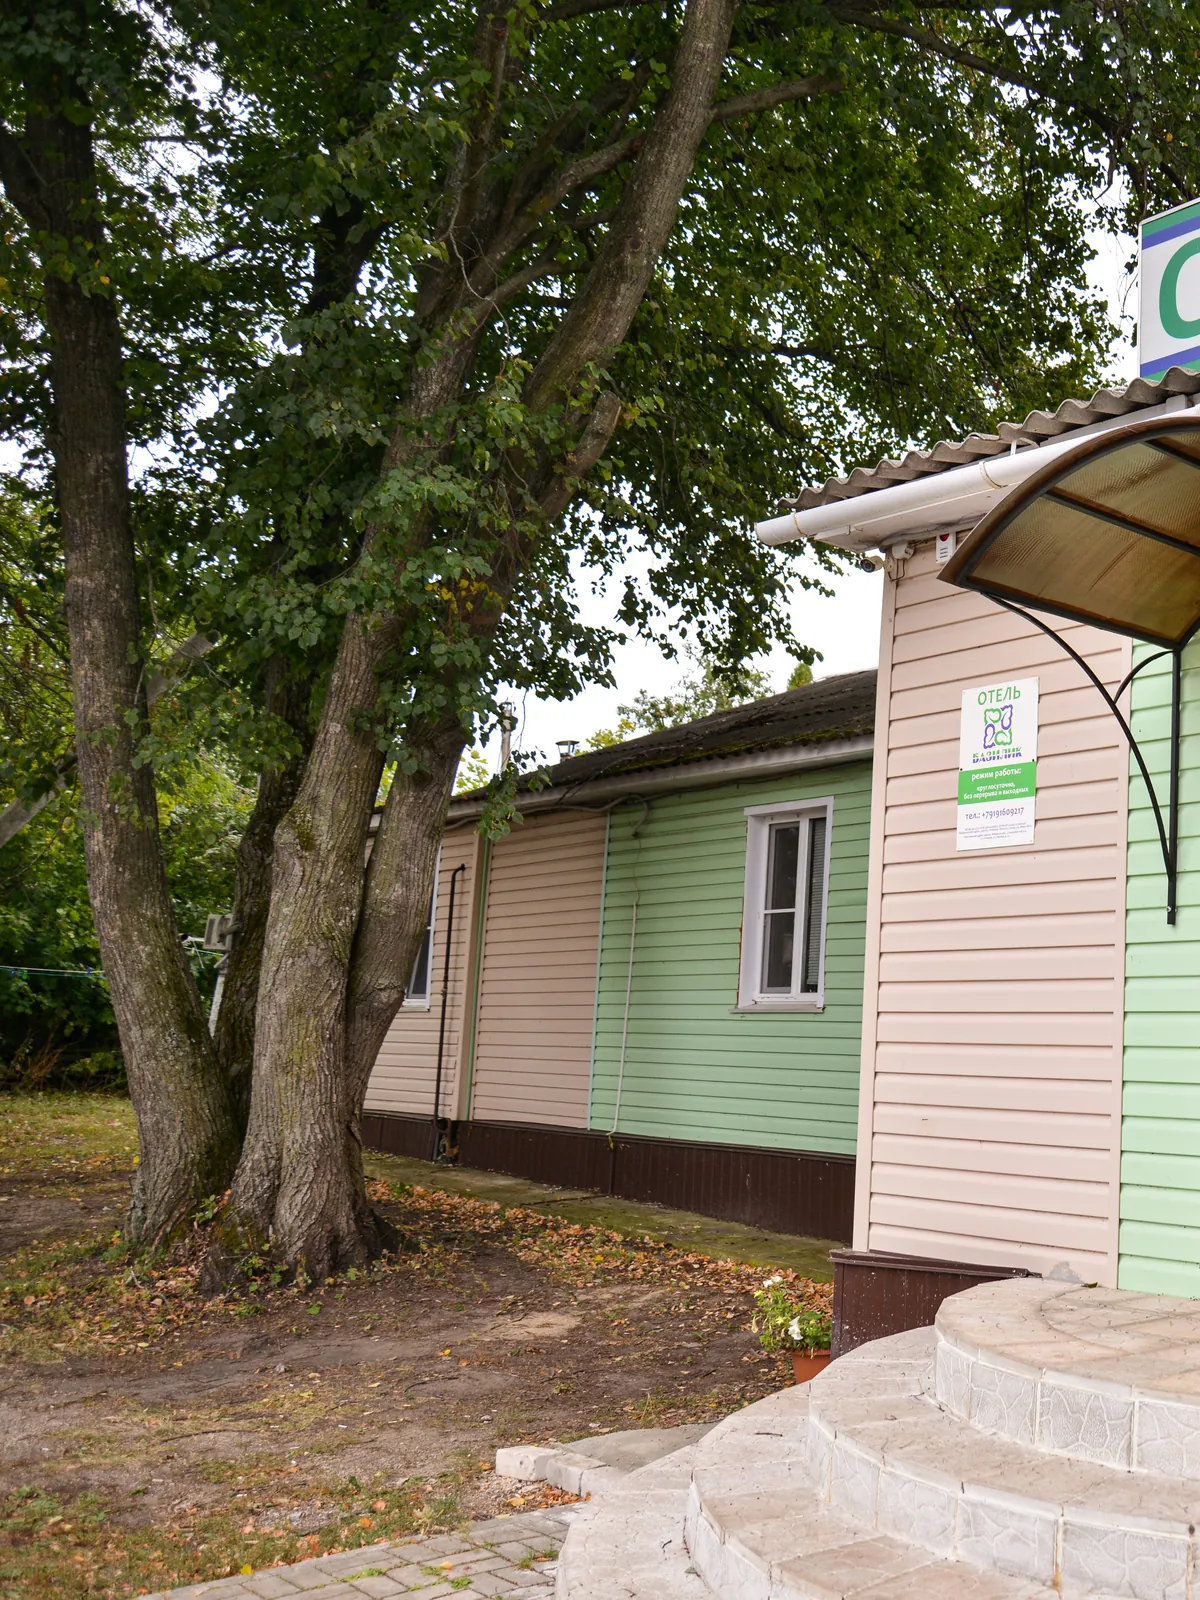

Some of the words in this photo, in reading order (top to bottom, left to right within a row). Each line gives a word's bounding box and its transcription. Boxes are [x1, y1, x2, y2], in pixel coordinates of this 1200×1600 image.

[977, 685, 1021, 706] ОТЕЛЬ
[971, 771, 994, 782] режим
[994, 767, 1022, 779] работы:
[963, 792, 973, 800] без
[973, 790, 998, 799] перерыва
[1002, 787, 1029, 795] выходных
[976, 782, 1016, 792] круглосуточно,
[981, 807, 1025, 819] +79191609217
